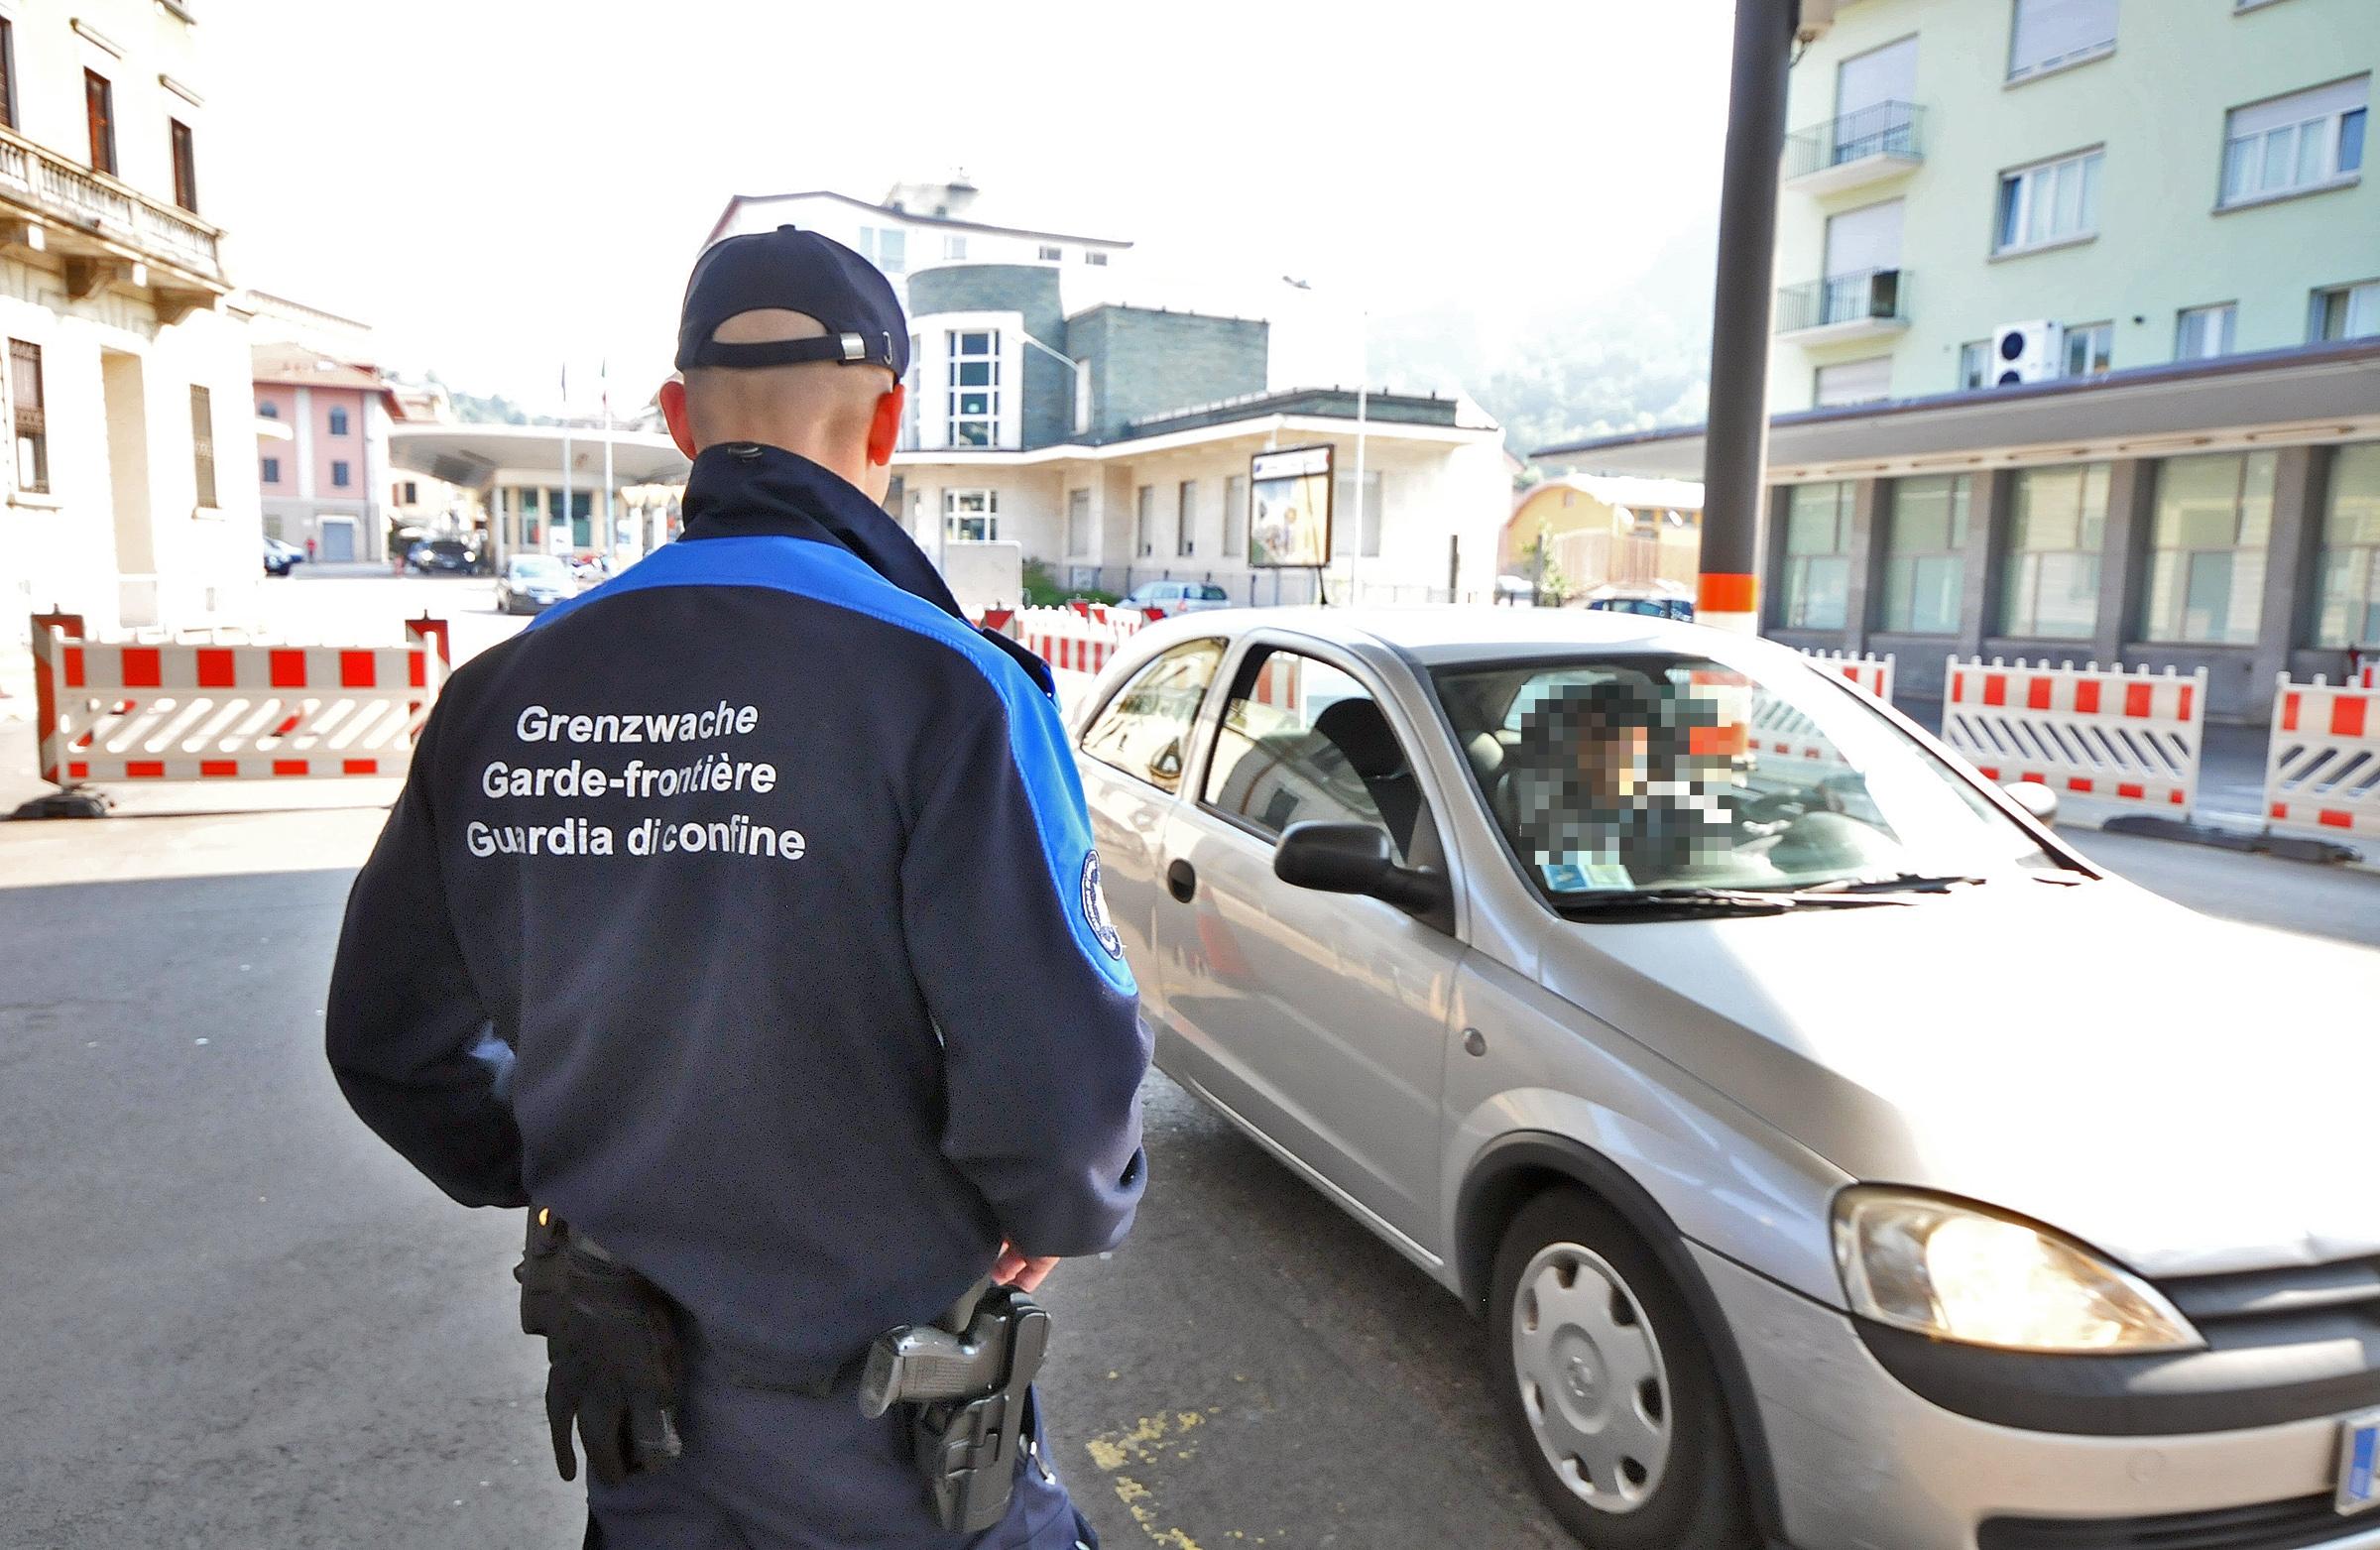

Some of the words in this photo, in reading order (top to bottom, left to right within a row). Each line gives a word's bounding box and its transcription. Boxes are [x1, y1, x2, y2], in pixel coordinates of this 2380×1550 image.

[517, 699, 759, 743] Grenzwache
[482, 752, 776, 798] Garde-frontière
[467, 817, 614, 858] Guardia
